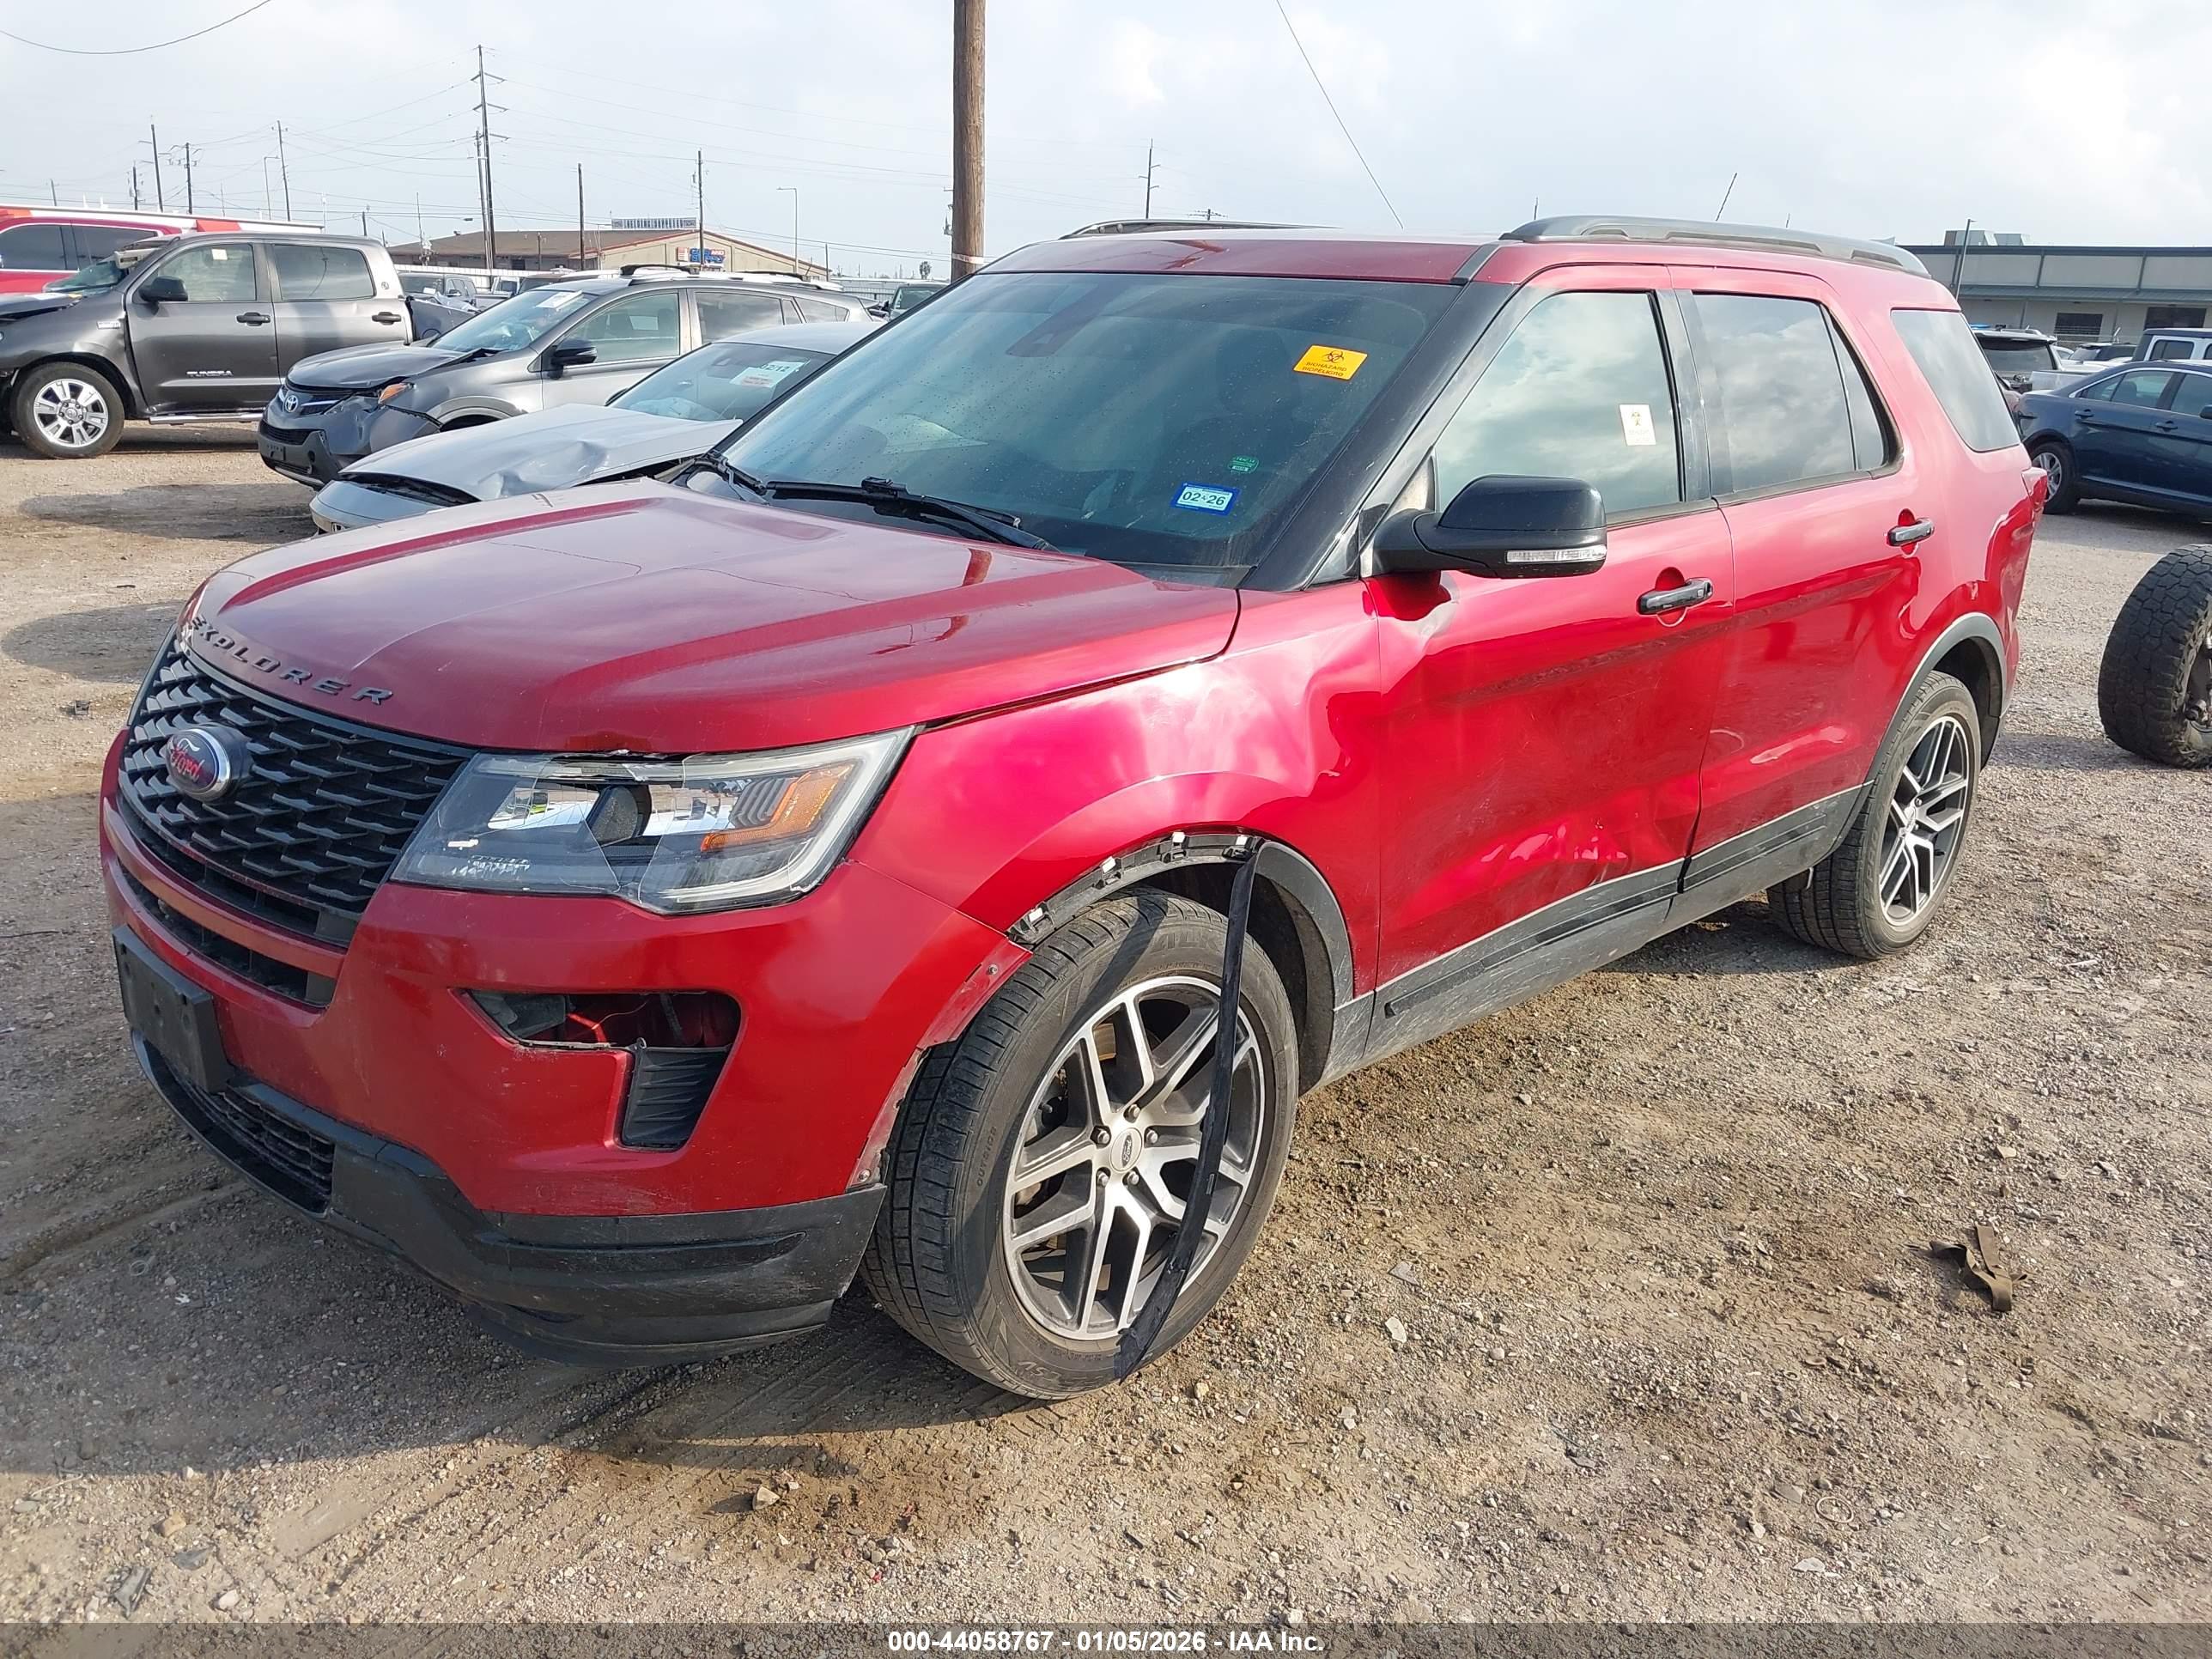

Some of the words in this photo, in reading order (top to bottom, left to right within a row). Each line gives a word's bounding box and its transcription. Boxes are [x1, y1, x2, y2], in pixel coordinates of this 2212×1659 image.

[1302, 367, 1344, 377] BIOPELIGRO
[1305, 362, 1347, 372] BIOHAZARD
[1182, 491, 1201, 502] 02
[1206, 495, 1226, 506] 26
[191, 613, 394, 706] EXPLORER
